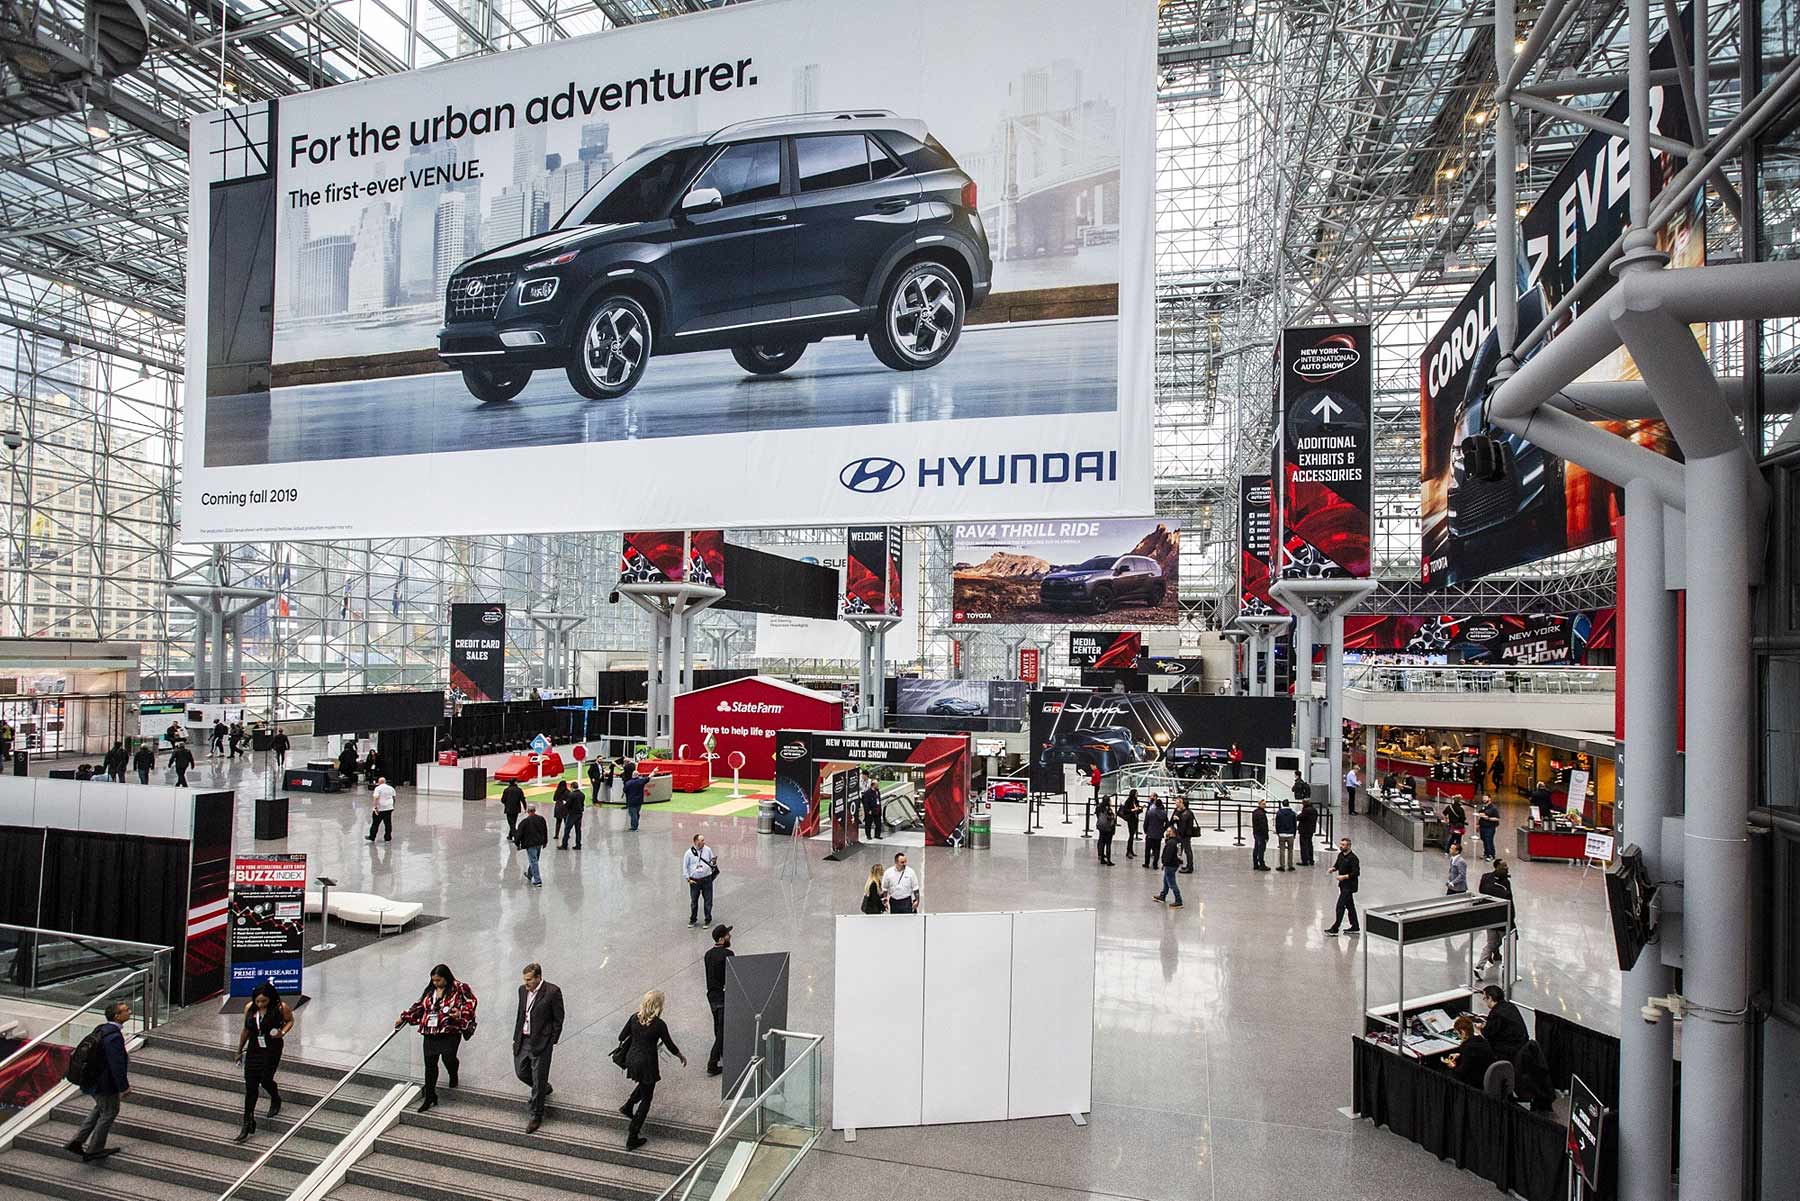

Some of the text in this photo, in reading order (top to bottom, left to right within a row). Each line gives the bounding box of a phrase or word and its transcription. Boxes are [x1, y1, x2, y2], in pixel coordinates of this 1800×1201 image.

[290, 58, 758, 168] For the urban adventurer.
[289, 160, 484, 209] The first-ever VENUE.
[1428, 280, 1497, 398] COROLL
[1297, 436, 1357, 450] ADDITIONAL
[1299, 452, 1356, 466] EXHIBITS &
[918, 450, 1117, 488] HYUNDAI
[1292, 469, 1362, 482] ACCESSORIES
[201, 488, 298, 507] Coming fall 2019
[851, 532, 884, 541] WELCOME
[955, 523, 1100, 538] RAV4 THRILL RIDE
[1508, 625, 1560, 641] NEW YORK
[455, 639, 500, 648] CREDIT CARD
[1072, 638, 1096, 646] MEDIA
[466, 651, 488, 660] SALES
[1072, 646, 1101, 655] CENTER
[1502, 640, 1548, 659] AUTO
[1516, 647, 1568, 664] SHOW
[1042, 703, 1129, 718] GR Supra
[700, 724, 776, 738] Here to help life go
[842, 739, 860, 747] YORK
[861, 740, 912, 750] INTERNATIONAL
[236, 870, 302, 882] BUZZ INDEX
